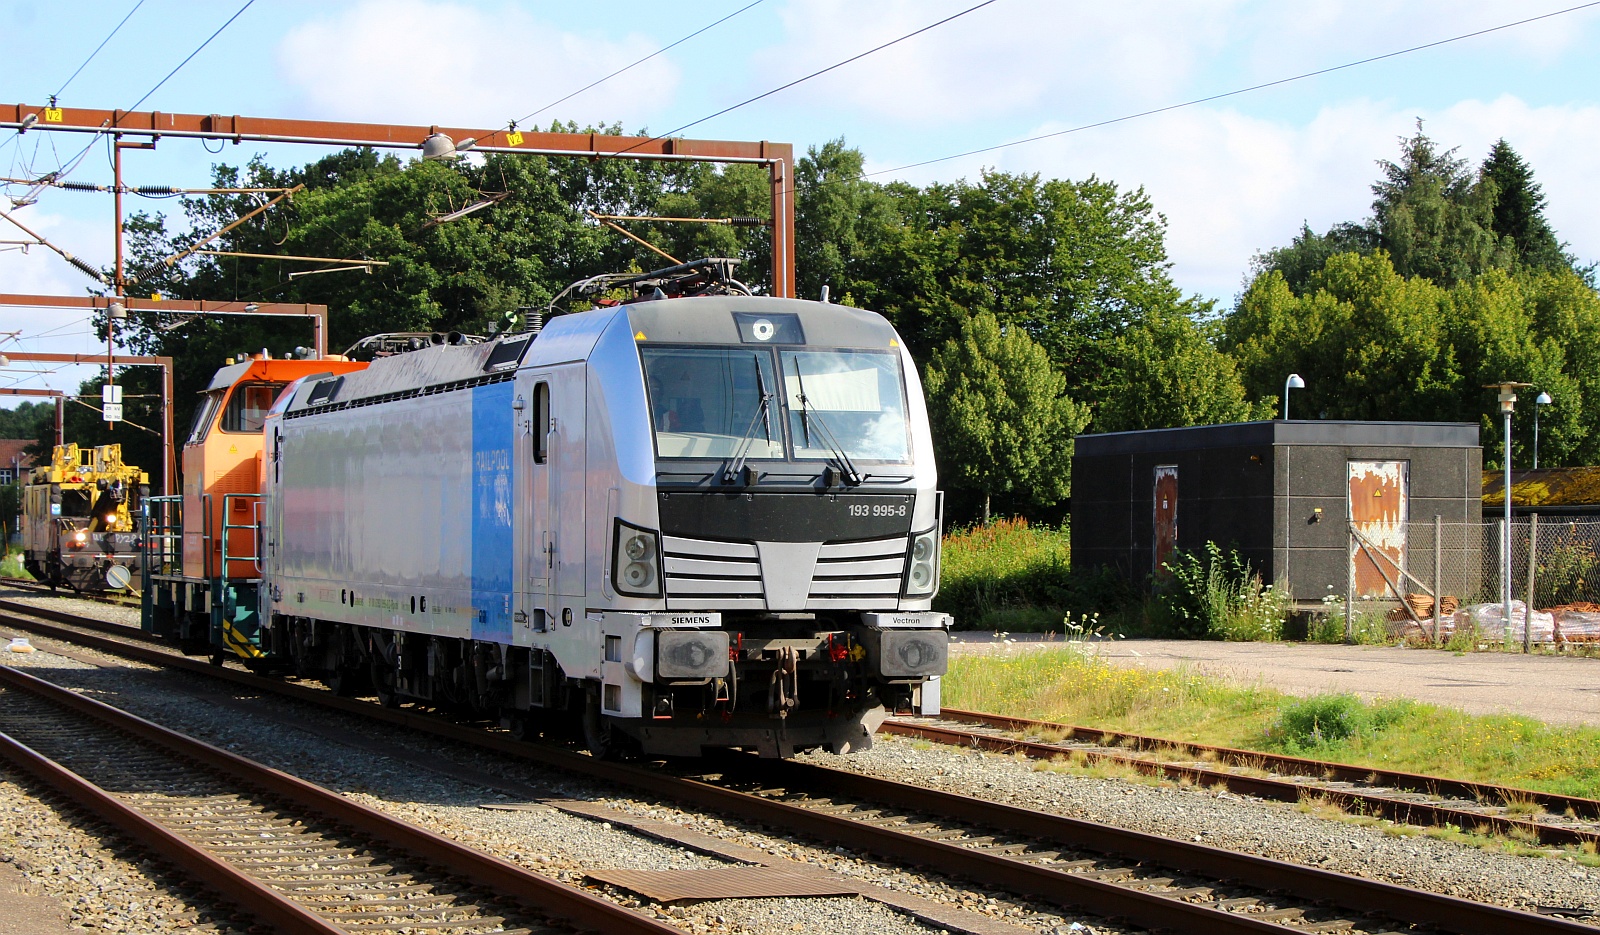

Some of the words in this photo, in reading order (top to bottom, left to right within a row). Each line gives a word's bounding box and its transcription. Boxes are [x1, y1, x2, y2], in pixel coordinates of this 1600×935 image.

[48, 111, 60, 121] V2
[509, 134, 522, 145] V2
[476, 449, 510, 471] RAILPOOL
[848, 504, 870, 517] 193
[872, 504, 907, 517] 995-8
[671, 616, 710, 625] SIEMENS
